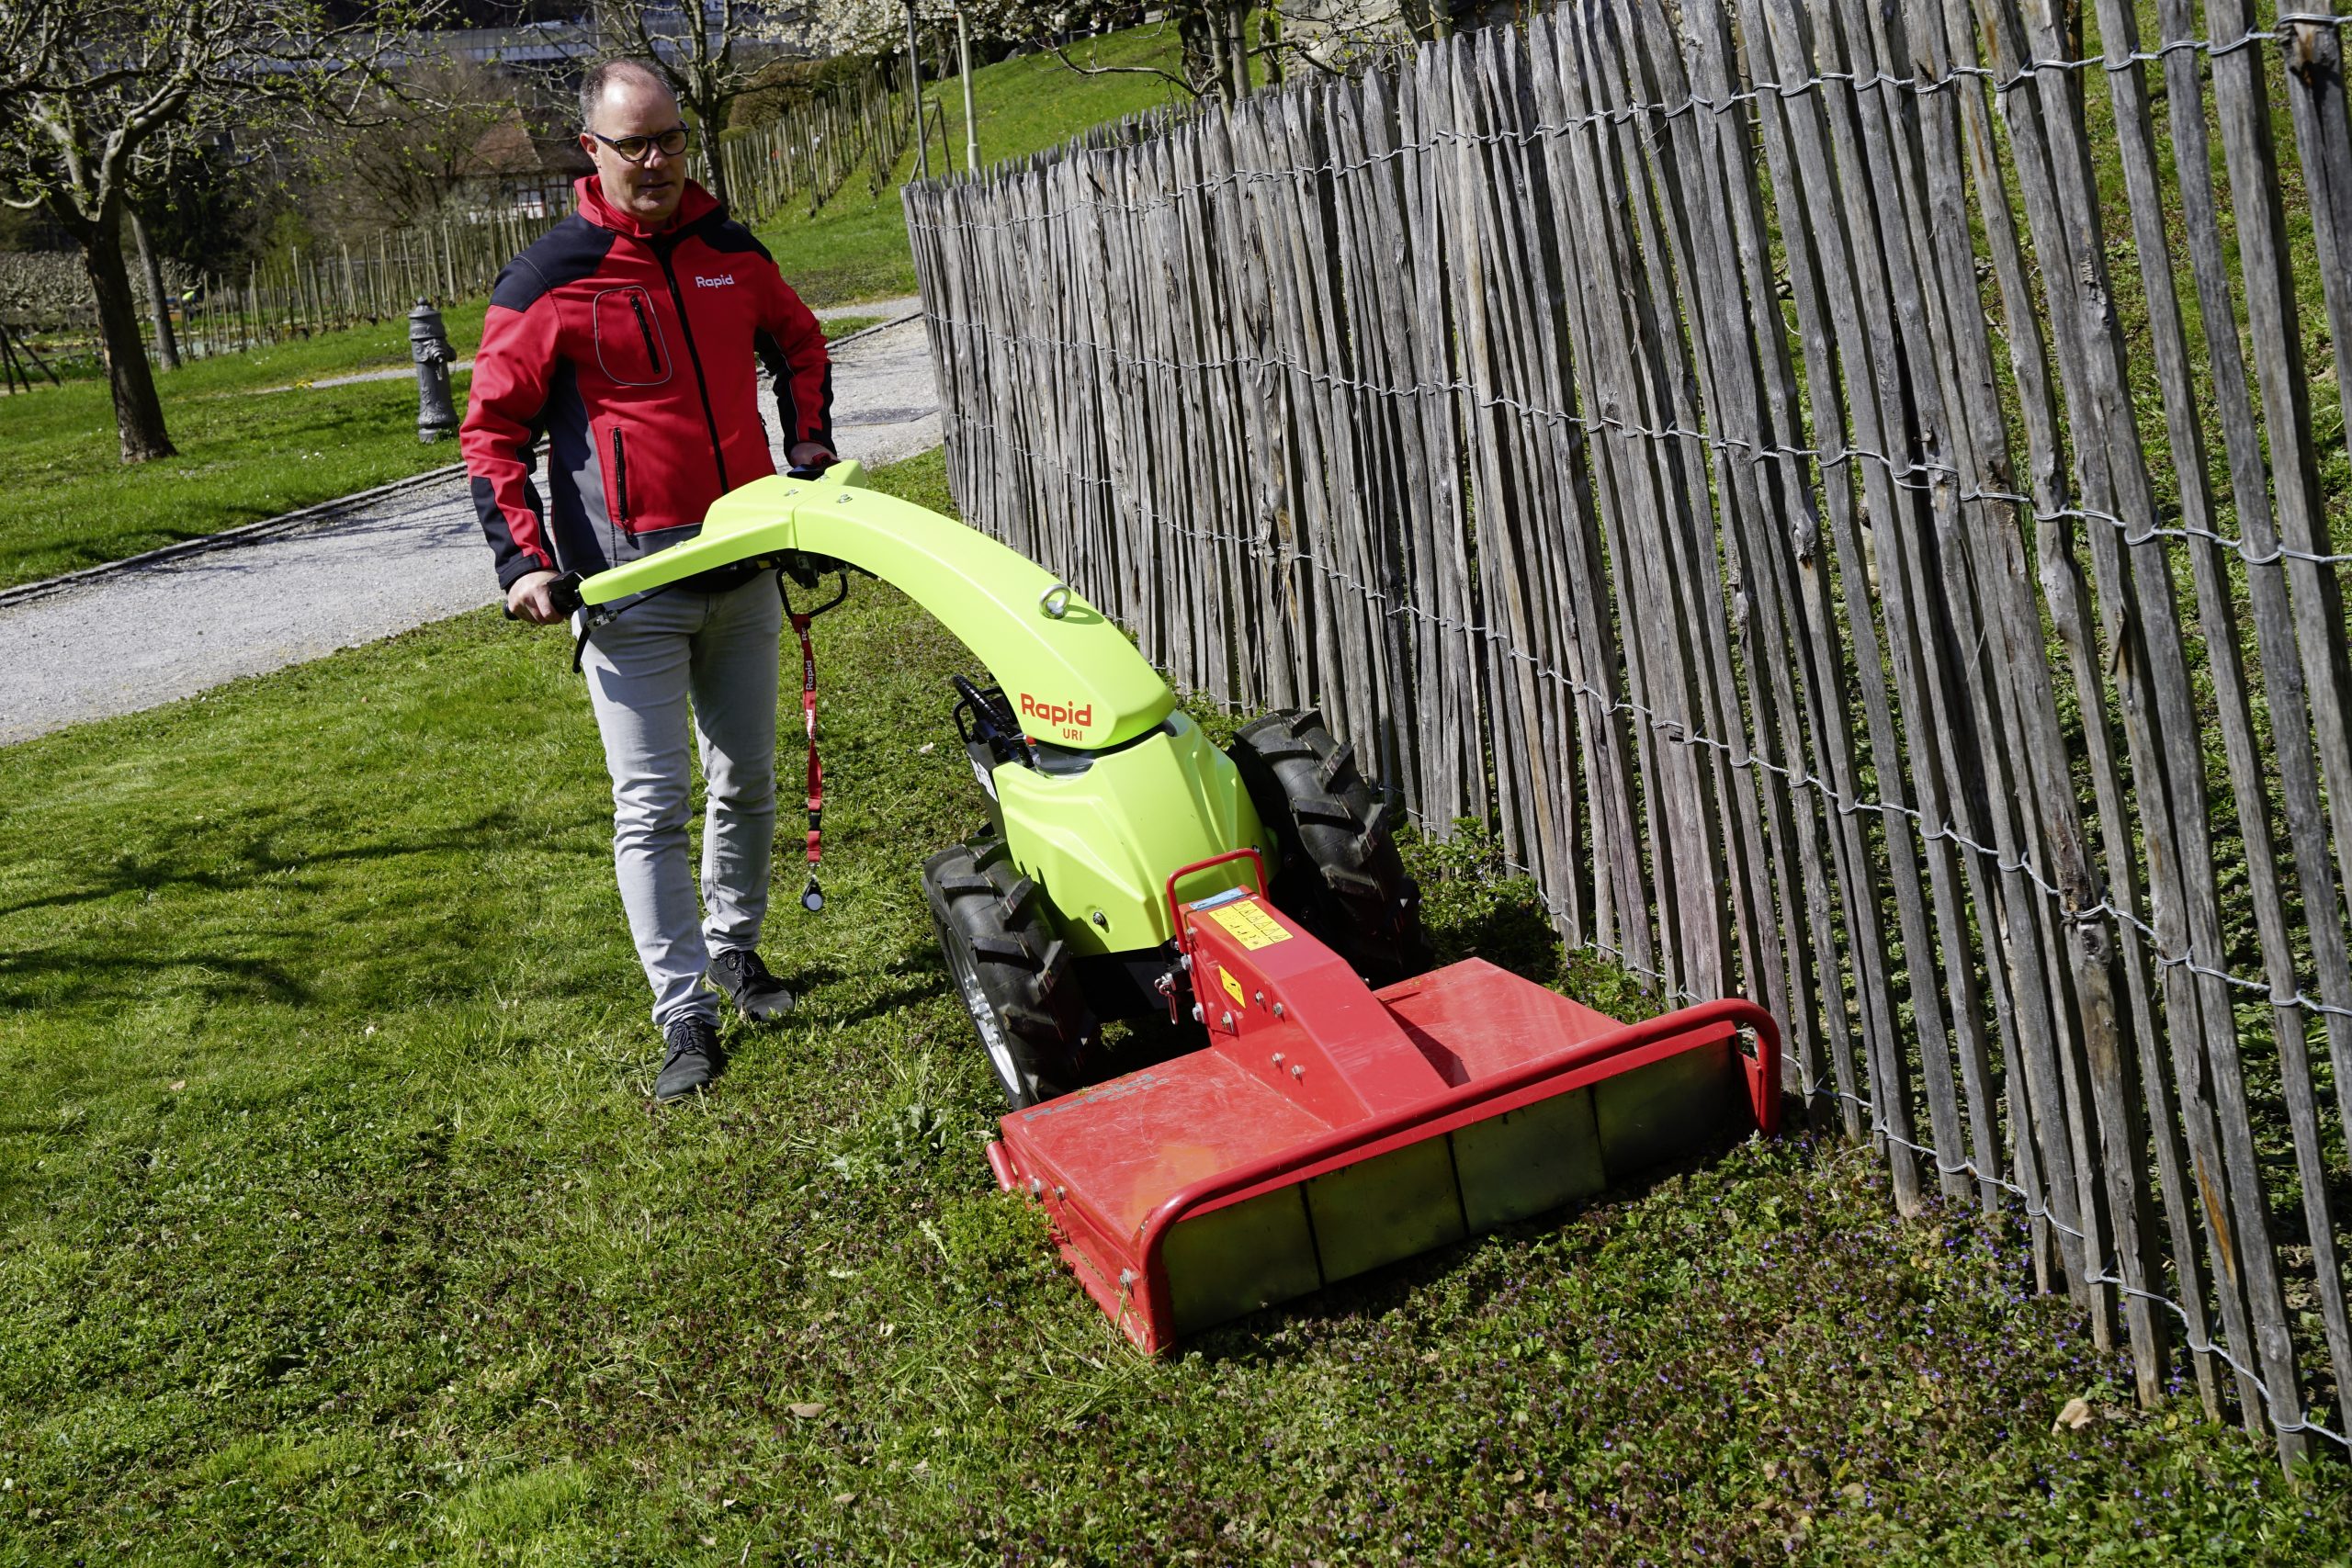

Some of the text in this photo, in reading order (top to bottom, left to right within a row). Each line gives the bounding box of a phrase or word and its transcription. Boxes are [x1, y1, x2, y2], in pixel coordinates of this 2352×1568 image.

[695, 274, 734, 288] Rapid
[806, 660, 814, 691] Rapid
[1021, 693, 1091, 727] Rapid
[1063, 728, 1082, 741] URI
